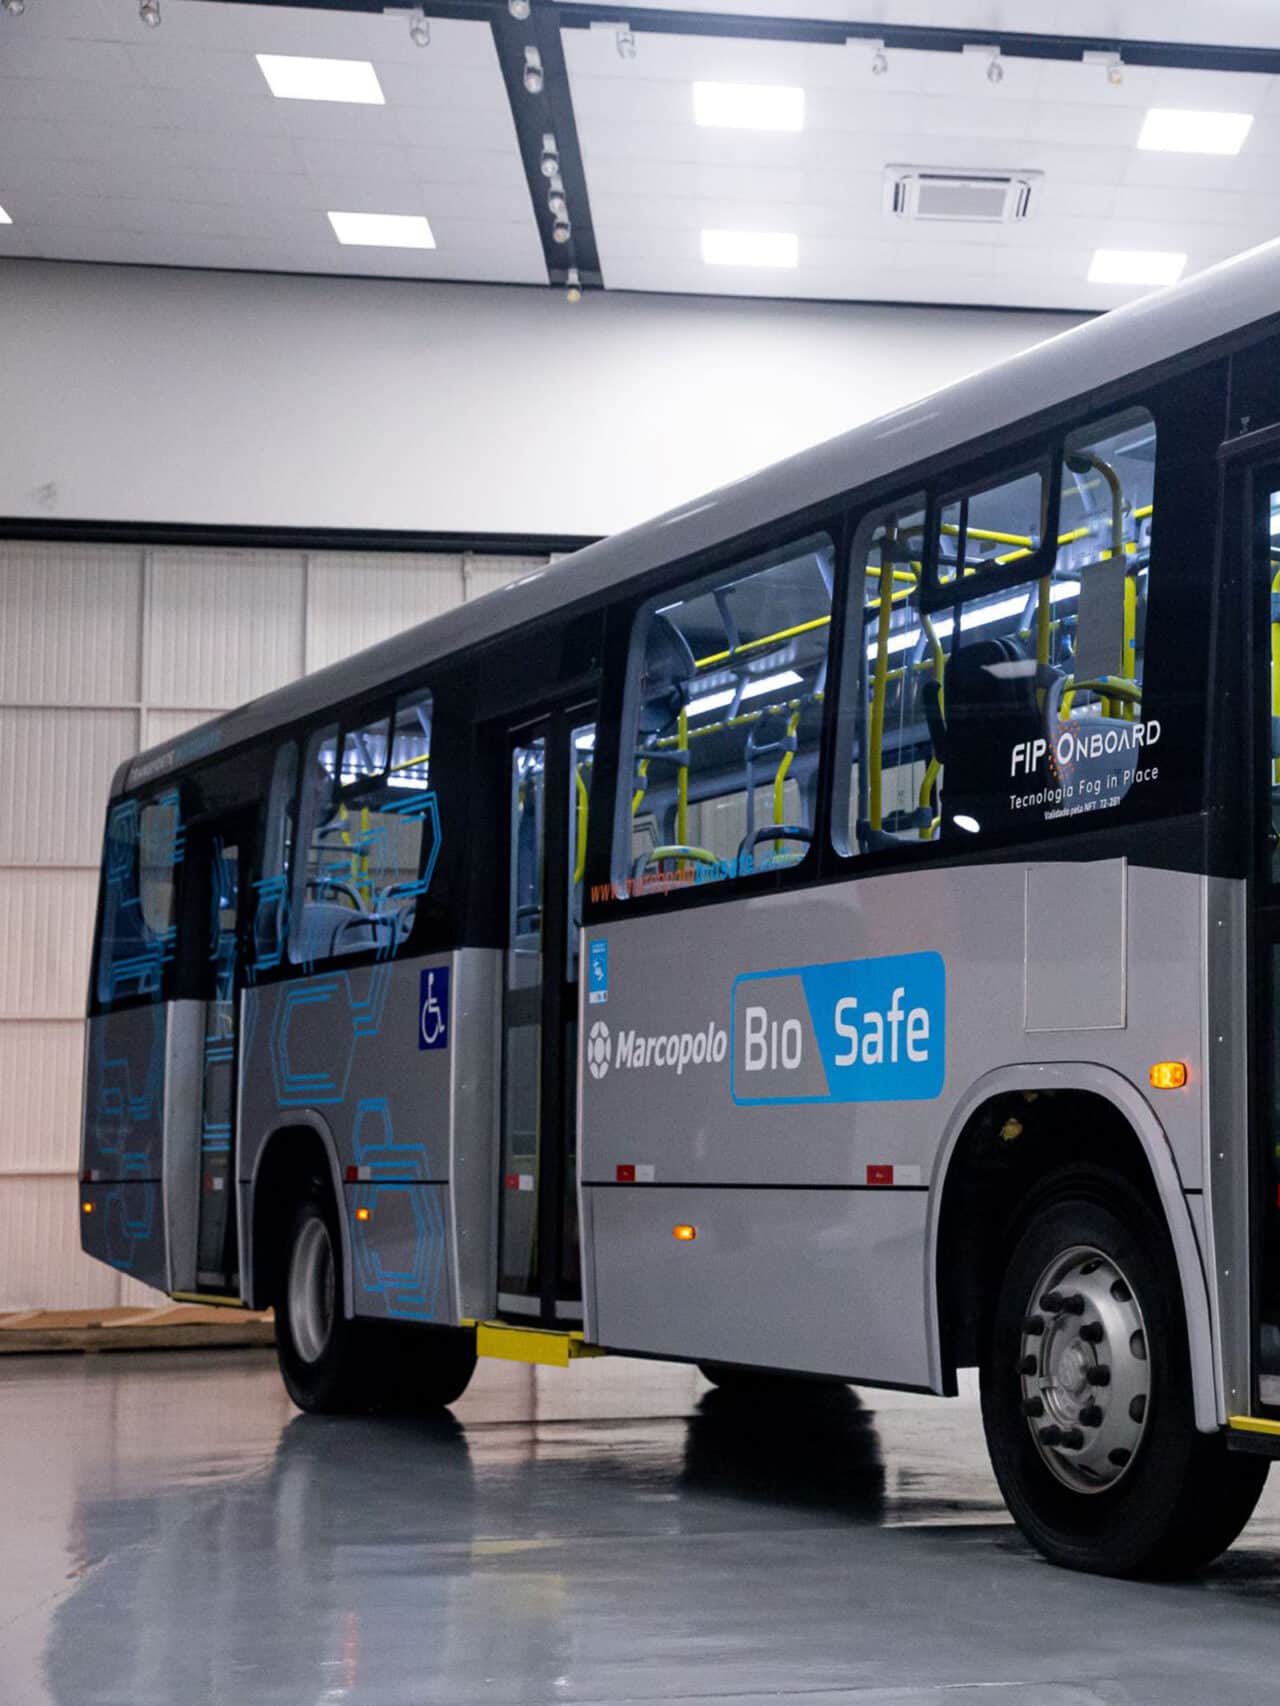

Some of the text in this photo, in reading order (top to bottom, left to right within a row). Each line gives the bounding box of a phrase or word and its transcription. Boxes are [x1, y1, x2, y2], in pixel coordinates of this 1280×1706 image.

[1010, 738, 1047, 777] FIP
[1009, 766, 1160, 810] Tecnologia Fog in Place
[616, 1021, 727, 1075] Marcopolo
[834, 987, 930, 1067] Safe
